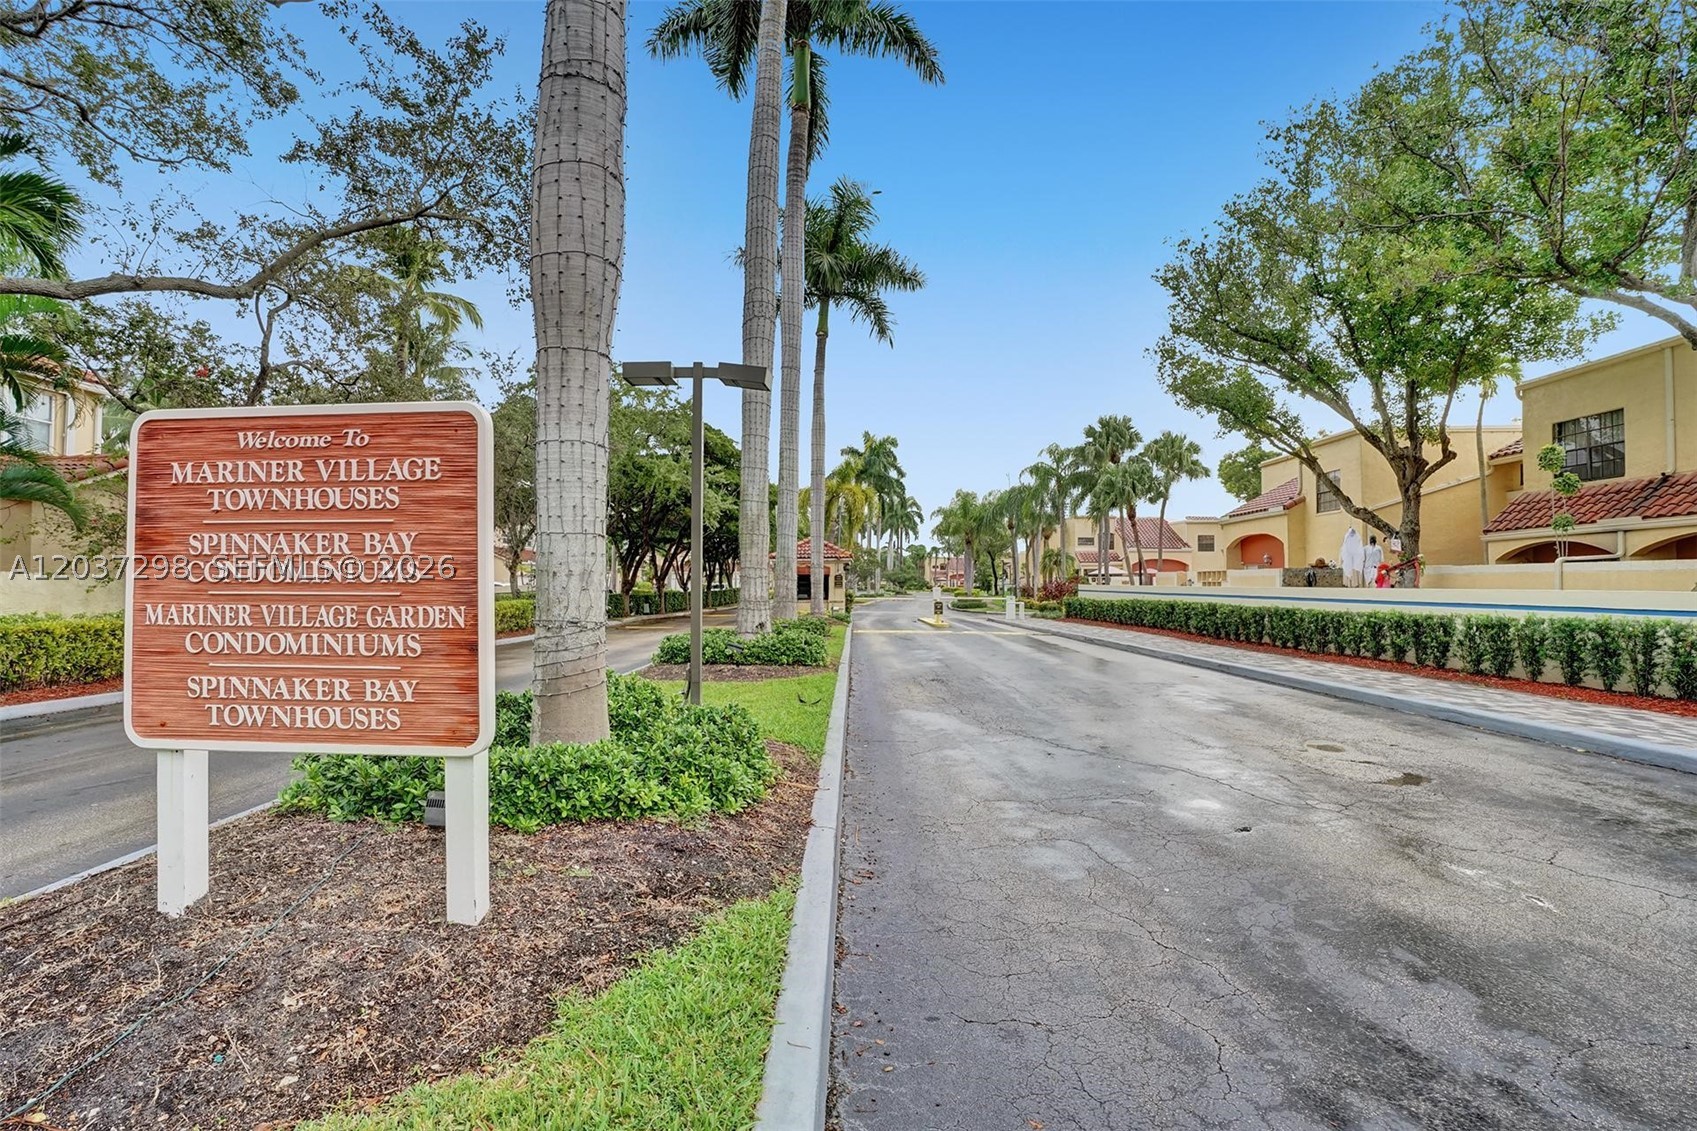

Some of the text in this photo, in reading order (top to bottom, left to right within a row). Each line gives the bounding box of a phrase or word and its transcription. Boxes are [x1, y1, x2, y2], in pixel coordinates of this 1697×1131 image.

[237, 429, 370, 449] Welcome To
[171, 457, 442, 485] MARINER VILLAGE
[207, 486, 400, 512] TOWNHOUSES
[188, 532, 419, 556] SPINNAKER BAY
[145, 603, 467, 630] MARINER VILLAGE GARDEN
[185, 631, 422, 658] CONDOMINIUMS
[187, 675, 420, 703] SPINNAKER BAY
[205, 704, 401, 731] TOWNHOUSES
